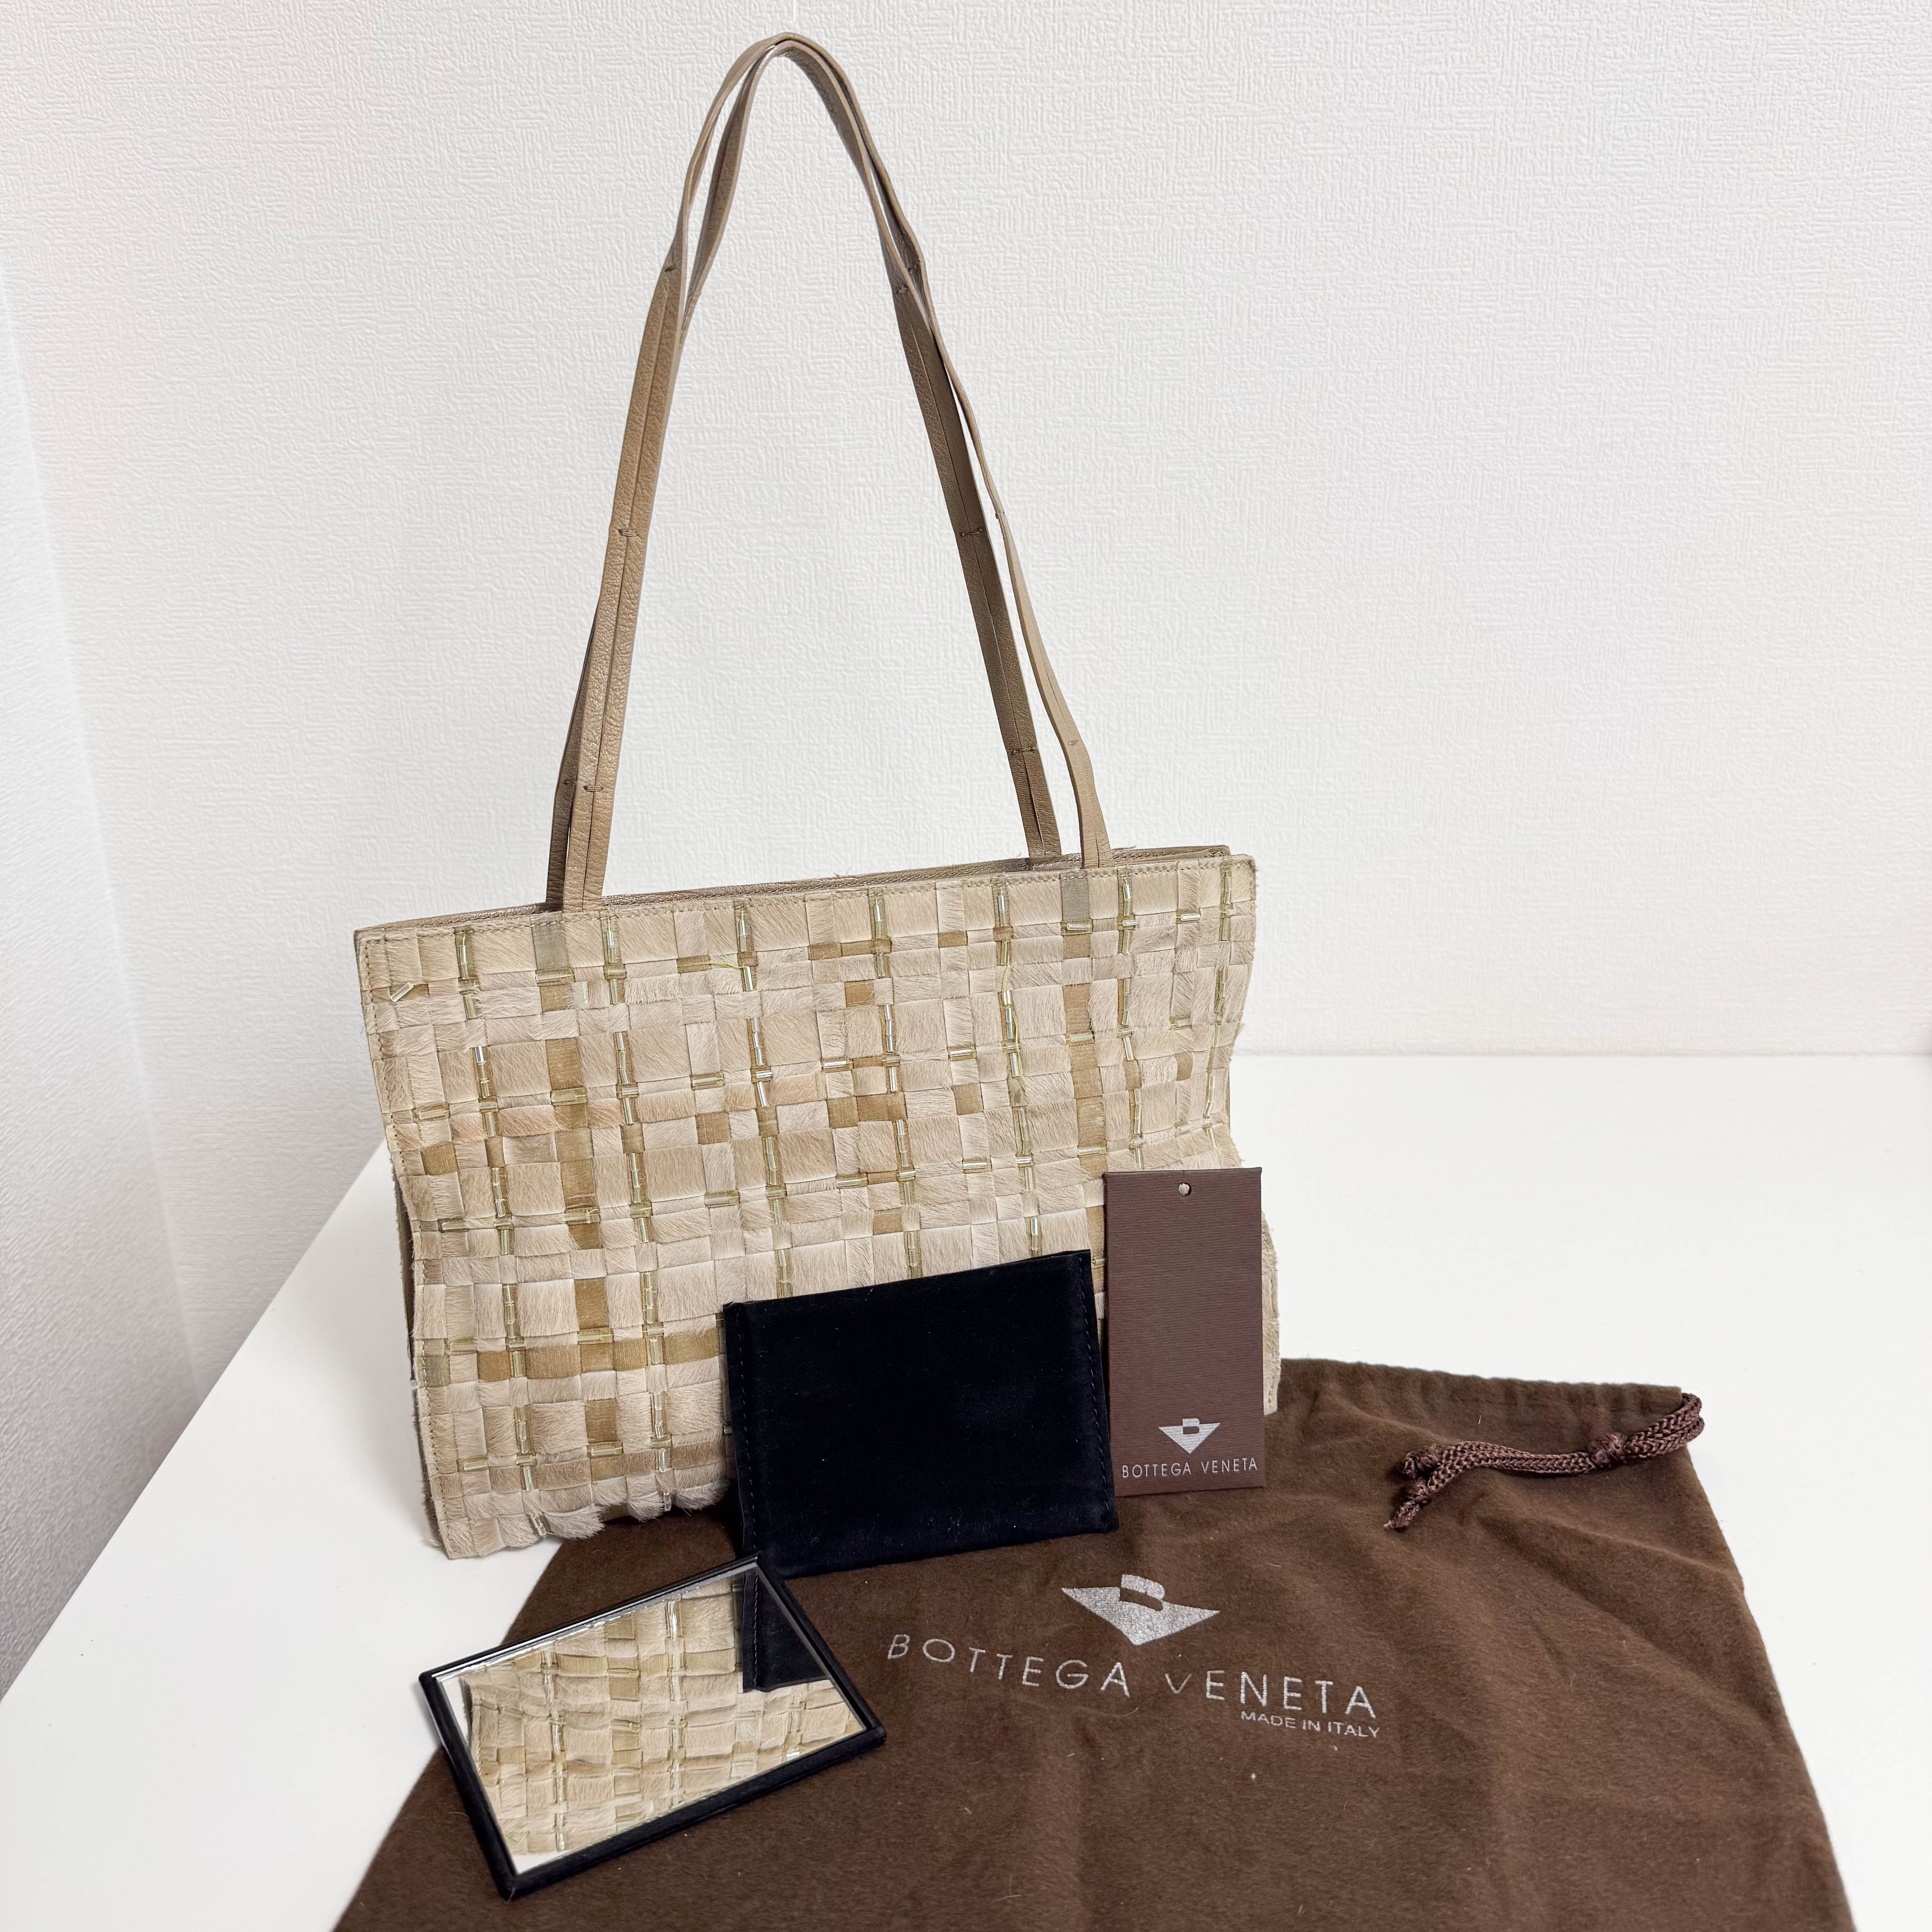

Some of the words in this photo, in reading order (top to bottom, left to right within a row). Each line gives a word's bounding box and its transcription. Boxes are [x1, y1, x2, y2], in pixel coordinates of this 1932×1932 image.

[1122, 1462, 1191, 1478] BOTTEGA
[1201, 1457, 1258, 1474] VENETA
[887, 1634, 1131, 1697] BOTTEGA
[1164, 1670, 1376, 1718] VENETA
[1241, 1711, 1296, 1730] MADE
[1302, 1720, 1322, 1731] IN
[1328, 1721, 1380, 1738] ITALY
